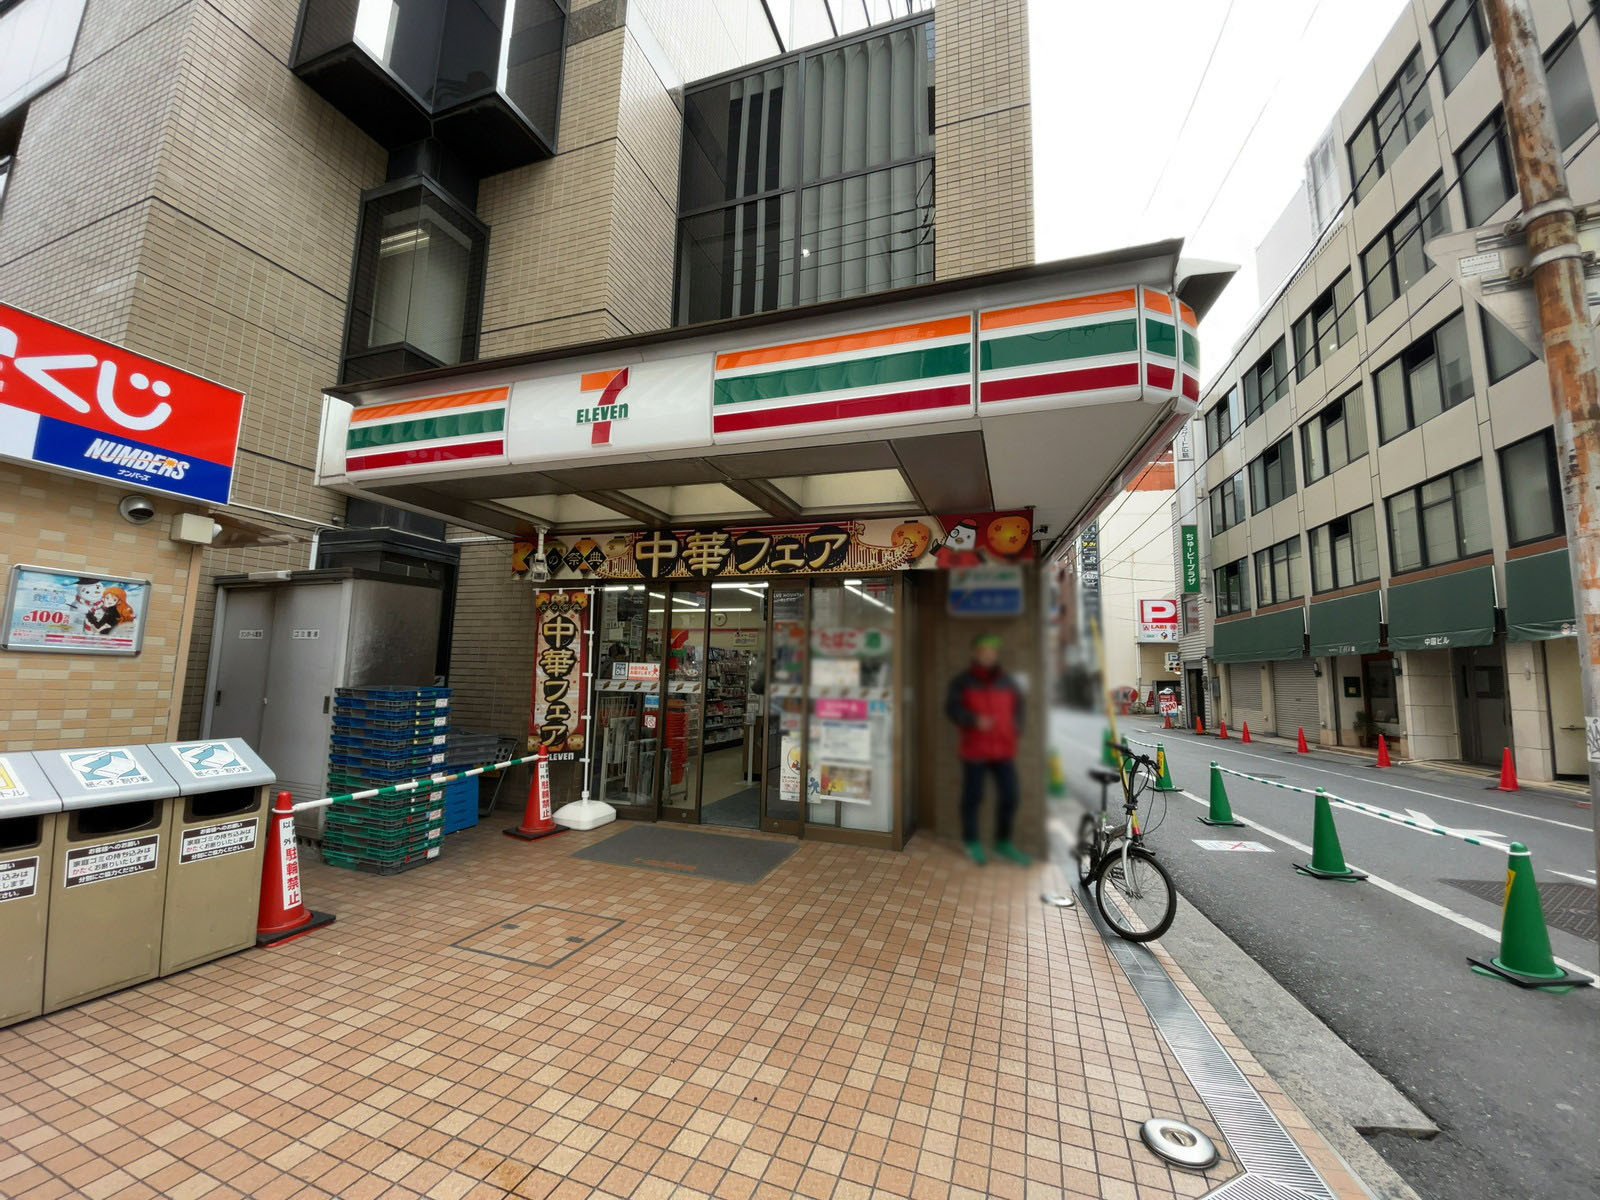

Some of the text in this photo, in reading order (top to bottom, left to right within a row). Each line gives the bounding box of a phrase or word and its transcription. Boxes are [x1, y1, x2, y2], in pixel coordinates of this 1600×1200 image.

[83, 438, 190, 480] NUMBERS
[117, 469, 152, 482] ナンバーズ
[635, 531, 849, 578] 中華フェア
[1143, 600, 1177, 623] P
[539, 616, 576, 746] 中華フェア
[285, 847, 301, 906] 駐輪禁止
